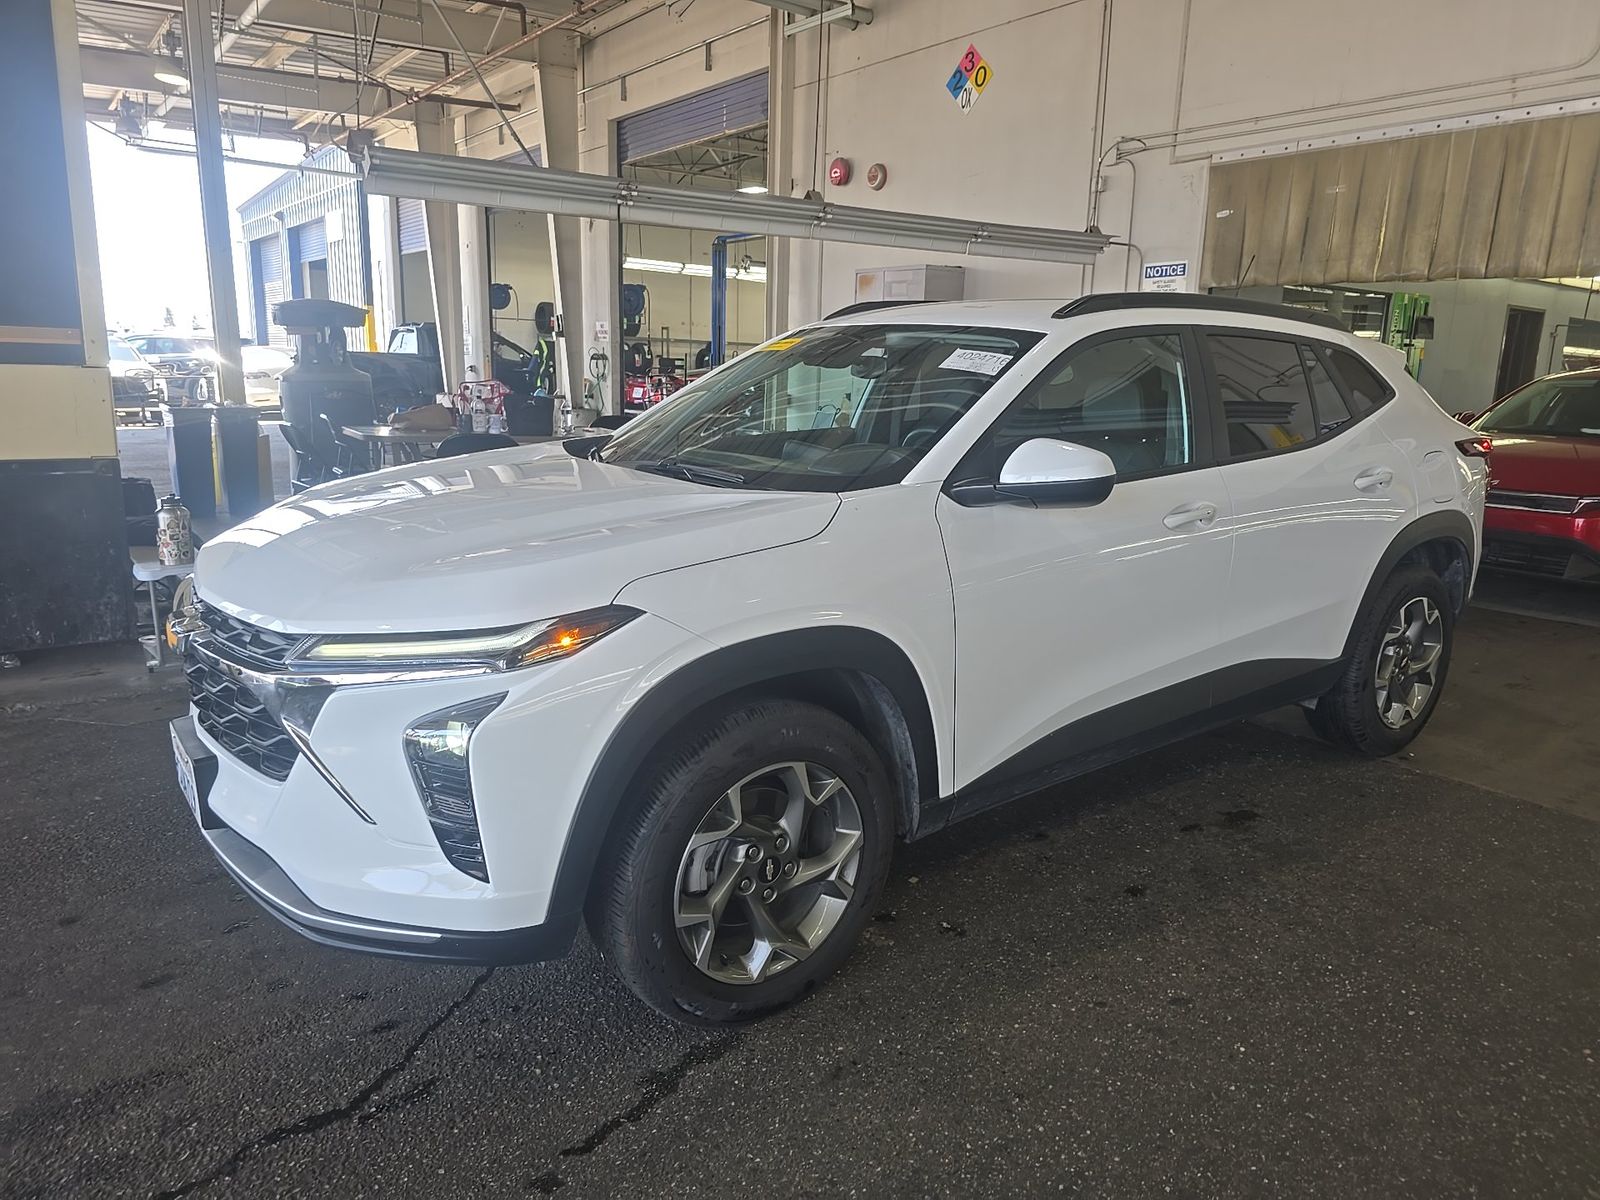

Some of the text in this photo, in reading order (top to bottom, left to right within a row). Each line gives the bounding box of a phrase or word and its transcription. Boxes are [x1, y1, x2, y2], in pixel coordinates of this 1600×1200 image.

[964, 51, 975, 73] 3
[953, 69, 964, 92] 2
[961, 87, 973, 109] OX
[1146, 265, 1184, 278] NOTICE
